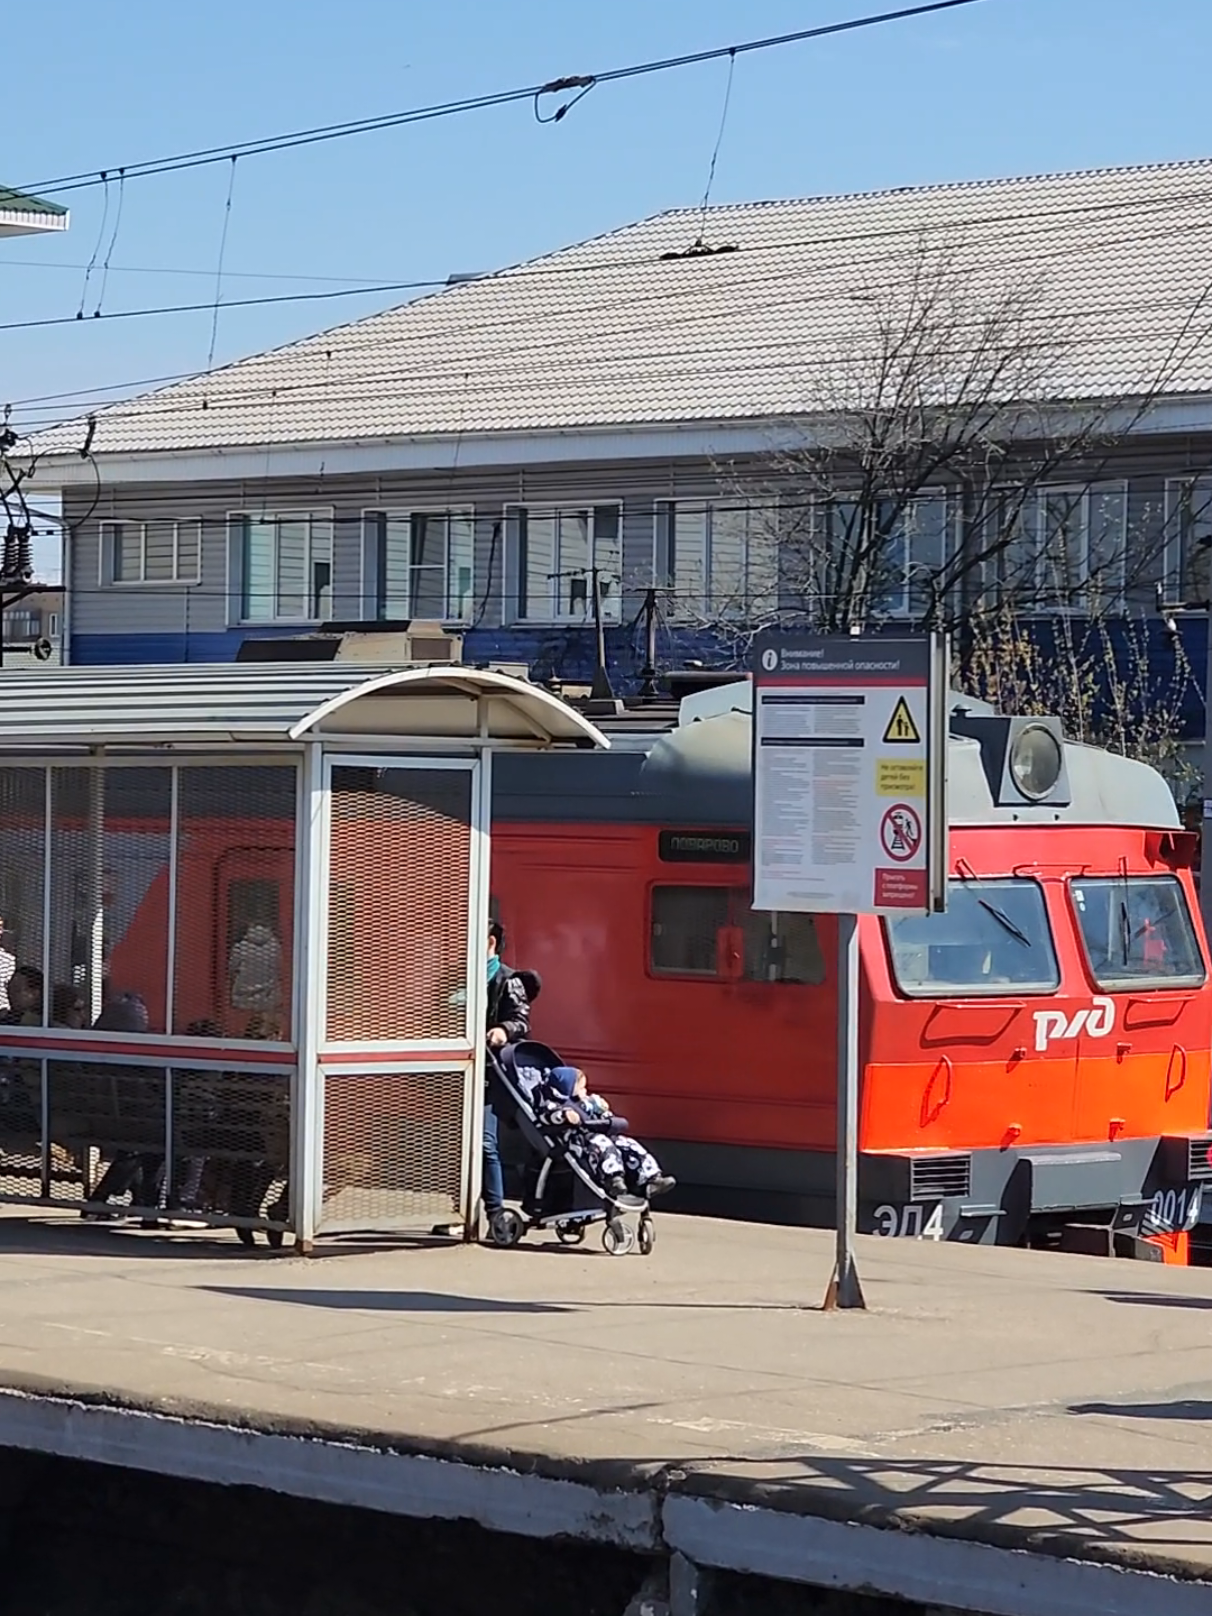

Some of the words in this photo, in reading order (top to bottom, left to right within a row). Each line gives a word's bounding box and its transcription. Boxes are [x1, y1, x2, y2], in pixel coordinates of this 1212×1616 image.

[780, 660, 800, 670] Зона
[801, 659, 854, 671] повышенной
[855, 660, 900, 671] опасности!
